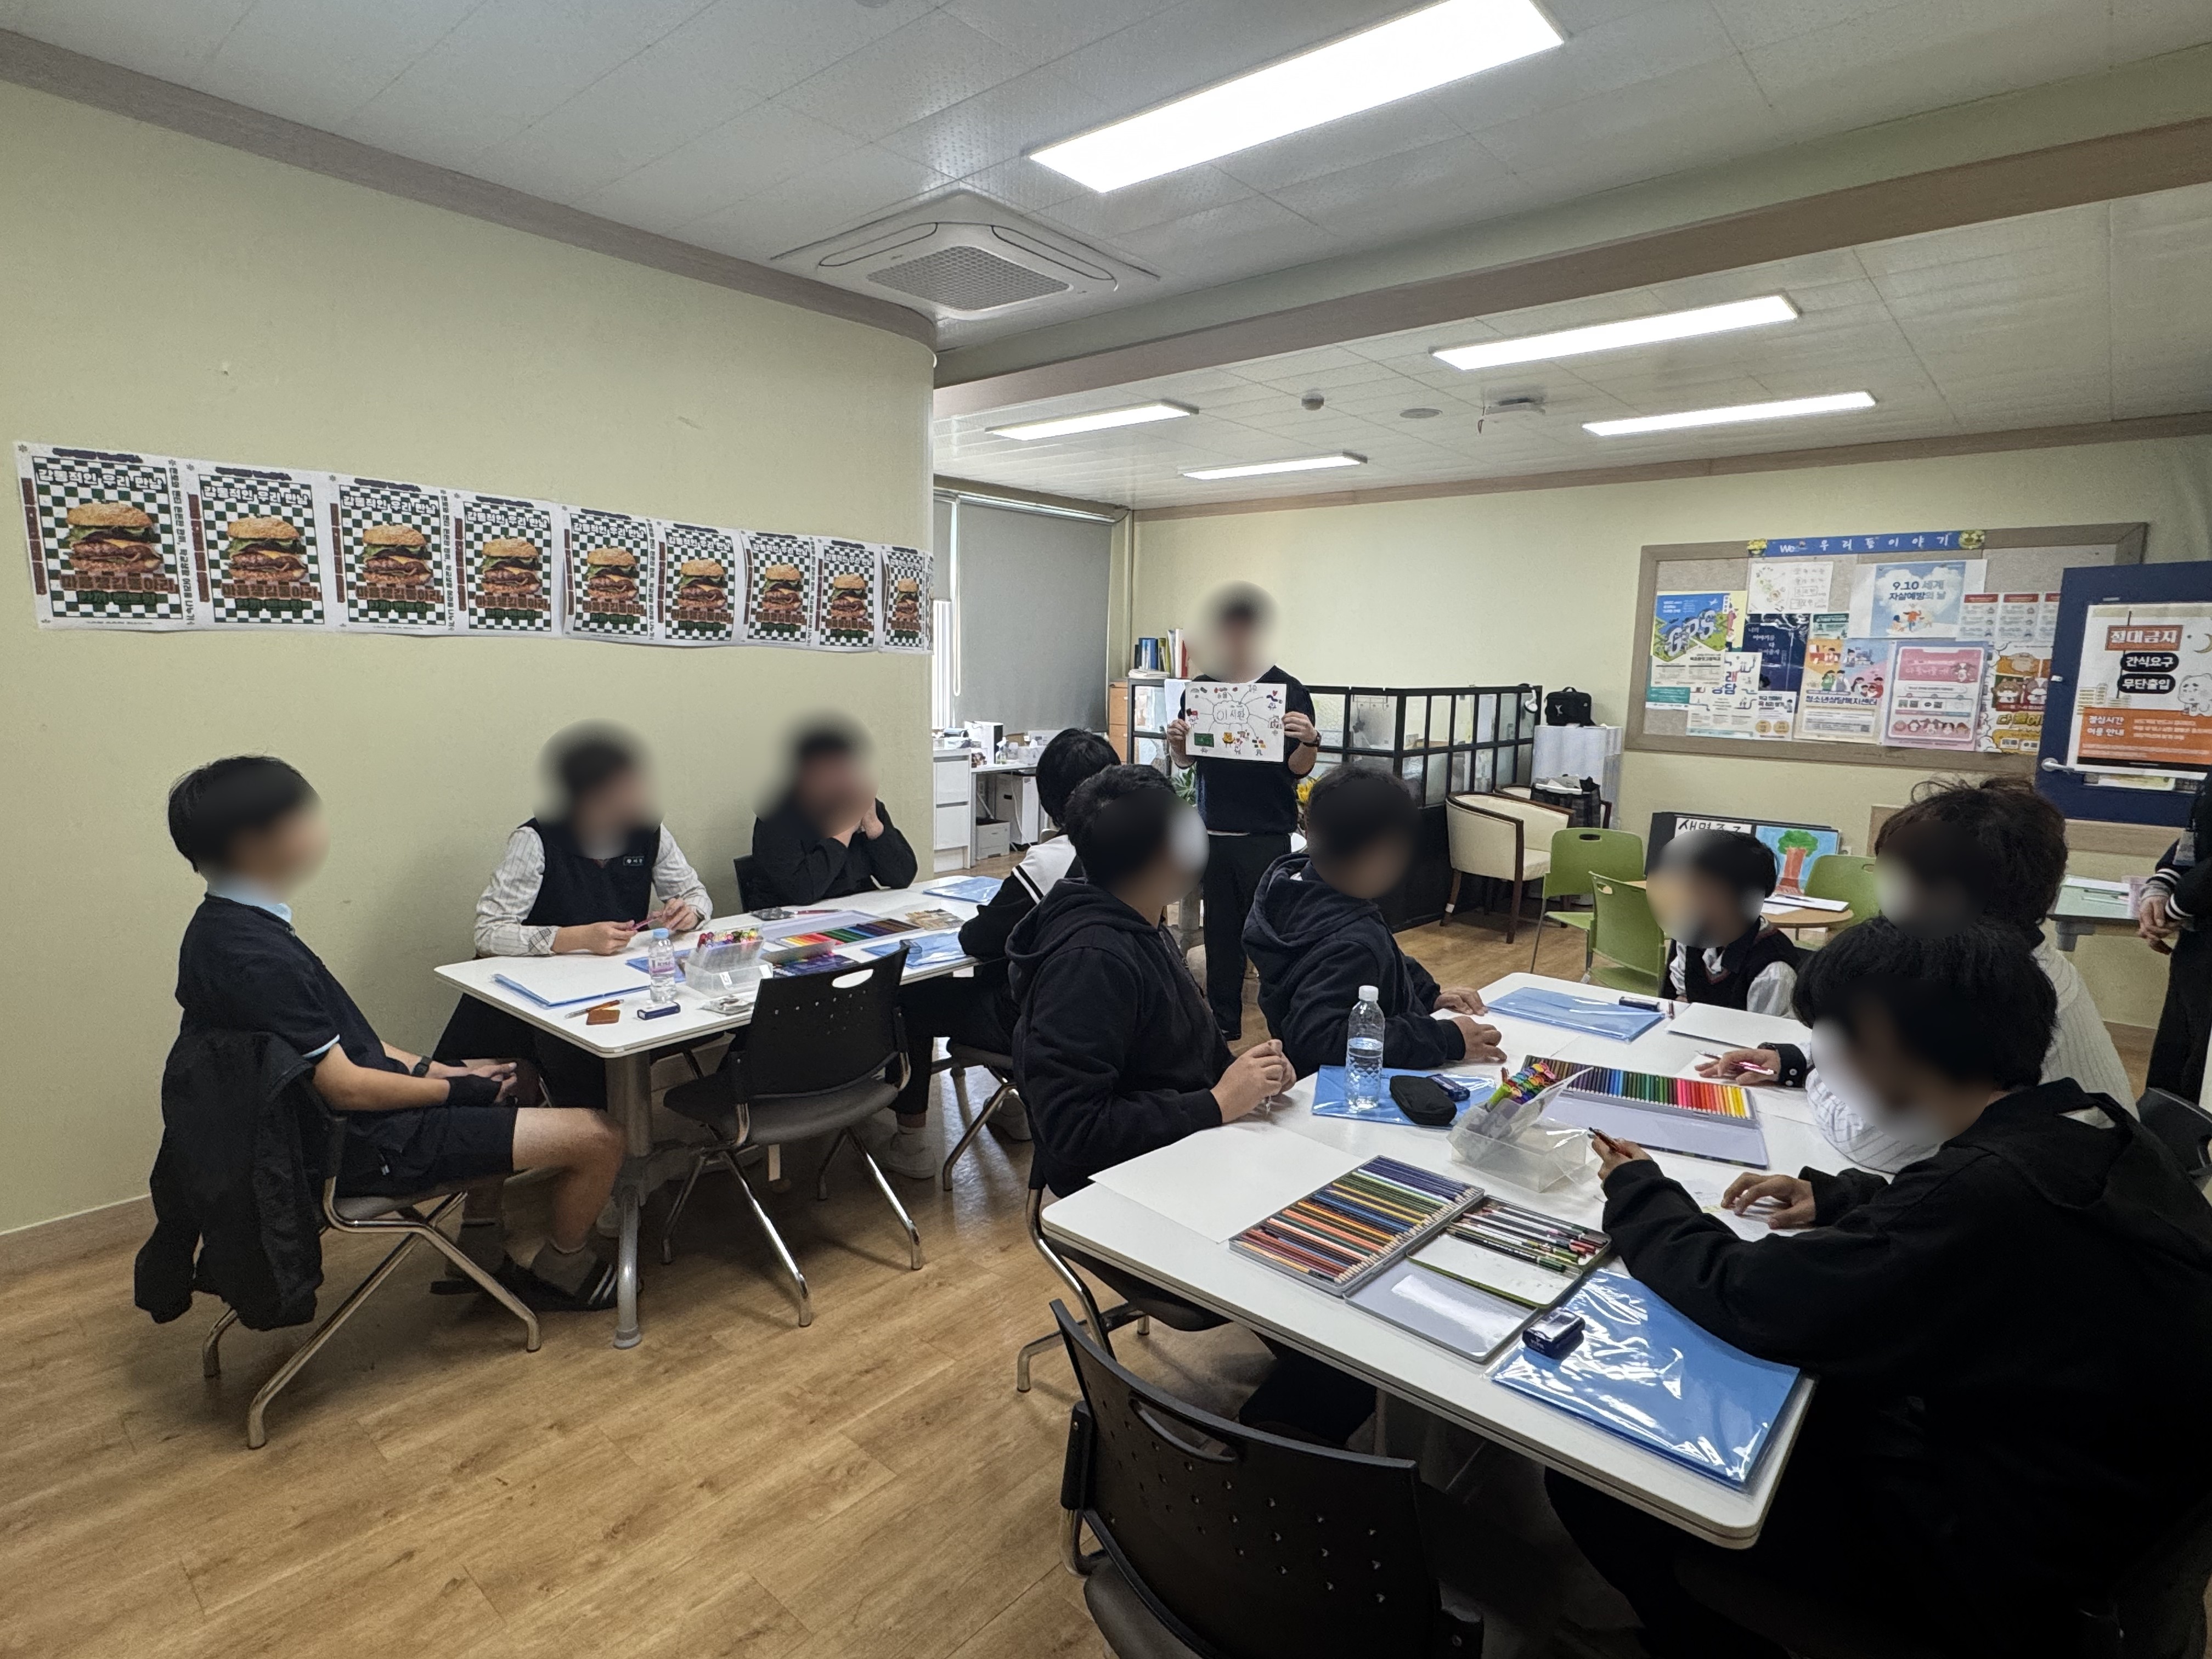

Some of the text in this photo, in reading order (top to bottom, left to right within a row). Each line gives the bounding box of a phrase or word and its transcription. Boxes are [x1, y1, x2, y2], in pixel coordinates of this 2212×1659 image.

[102, 473, 129, 486] 우리
[136, 476, 163, 490] 만남
[258, 490, 280, 503] 우리
[391, 500, 411, 511] 우리
[2110, 630, 2177, 644] 절대금지
[2125, 656, 2175, 668] 간식요구
[2121, 678, 2170, 691] 무단출입
[1805, 695, 1877, 706] 청소년상담복지센터
[2106, 727, 2125, 737] 안내
